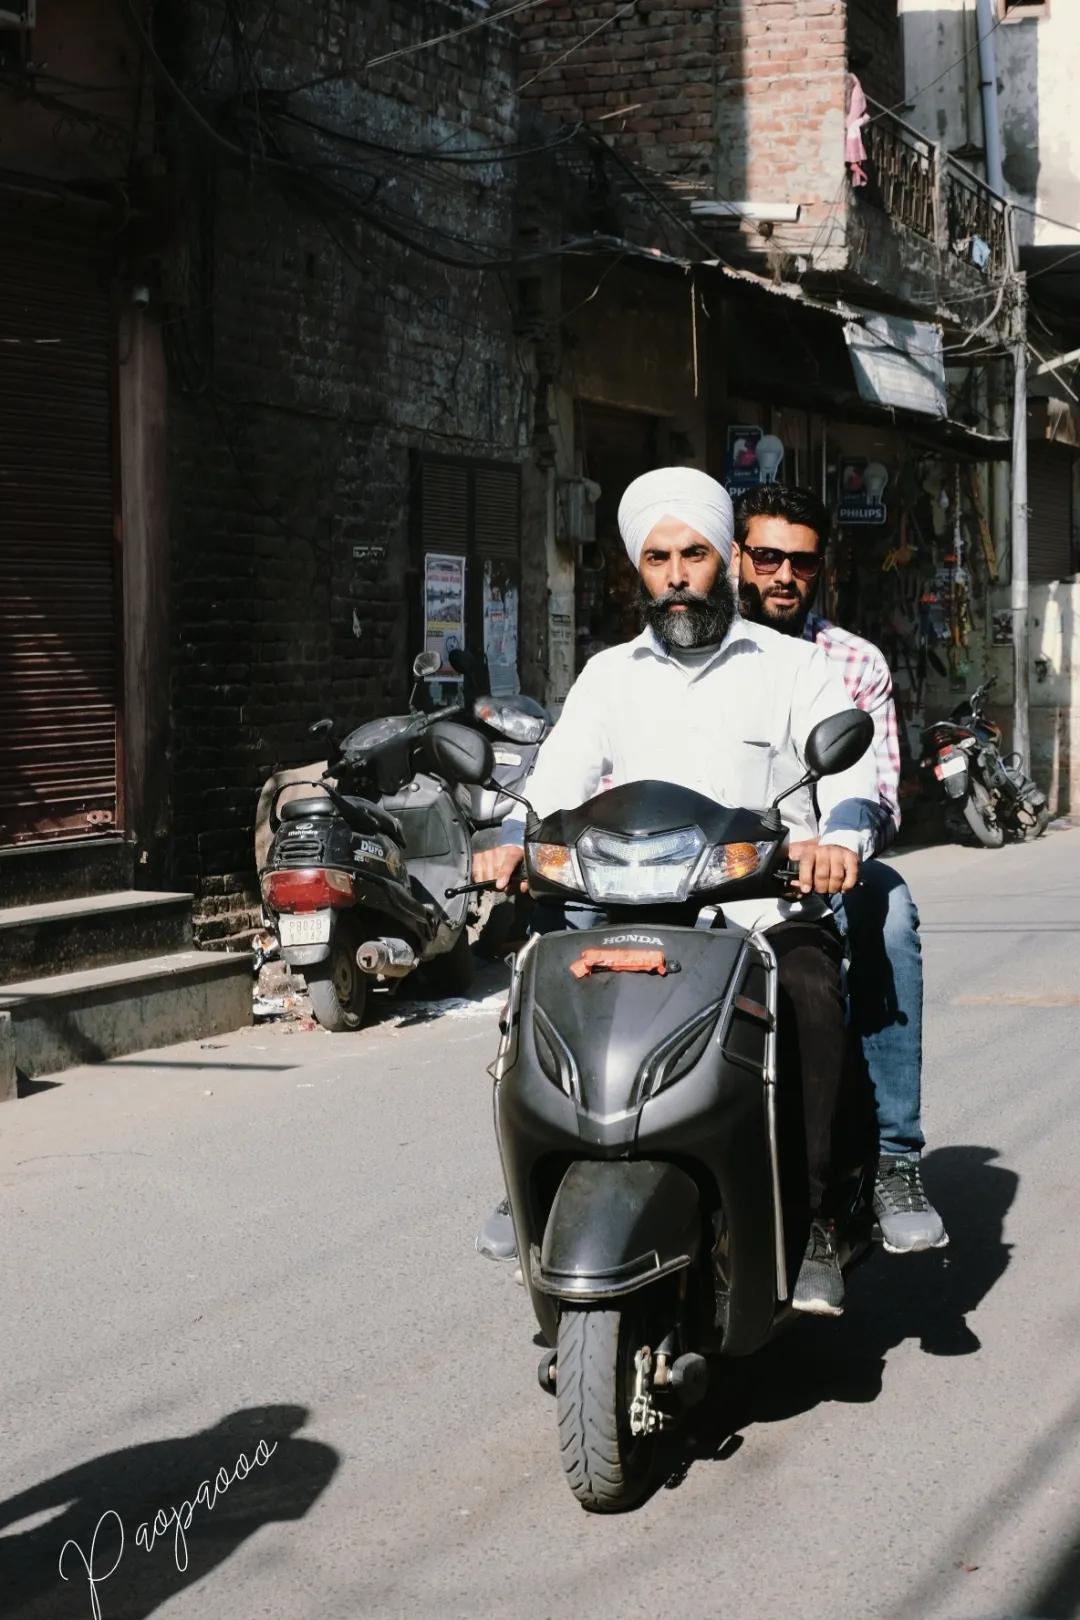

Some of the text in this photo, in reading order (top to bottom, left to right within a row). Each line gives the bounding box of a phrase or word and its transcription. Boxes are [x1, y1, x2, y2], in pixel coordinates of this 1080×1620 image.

[839, 508, 882, 519] PHILIPS
[360, 839, 384, 857] Duro
[602, 934, 665, 946] HONDA
